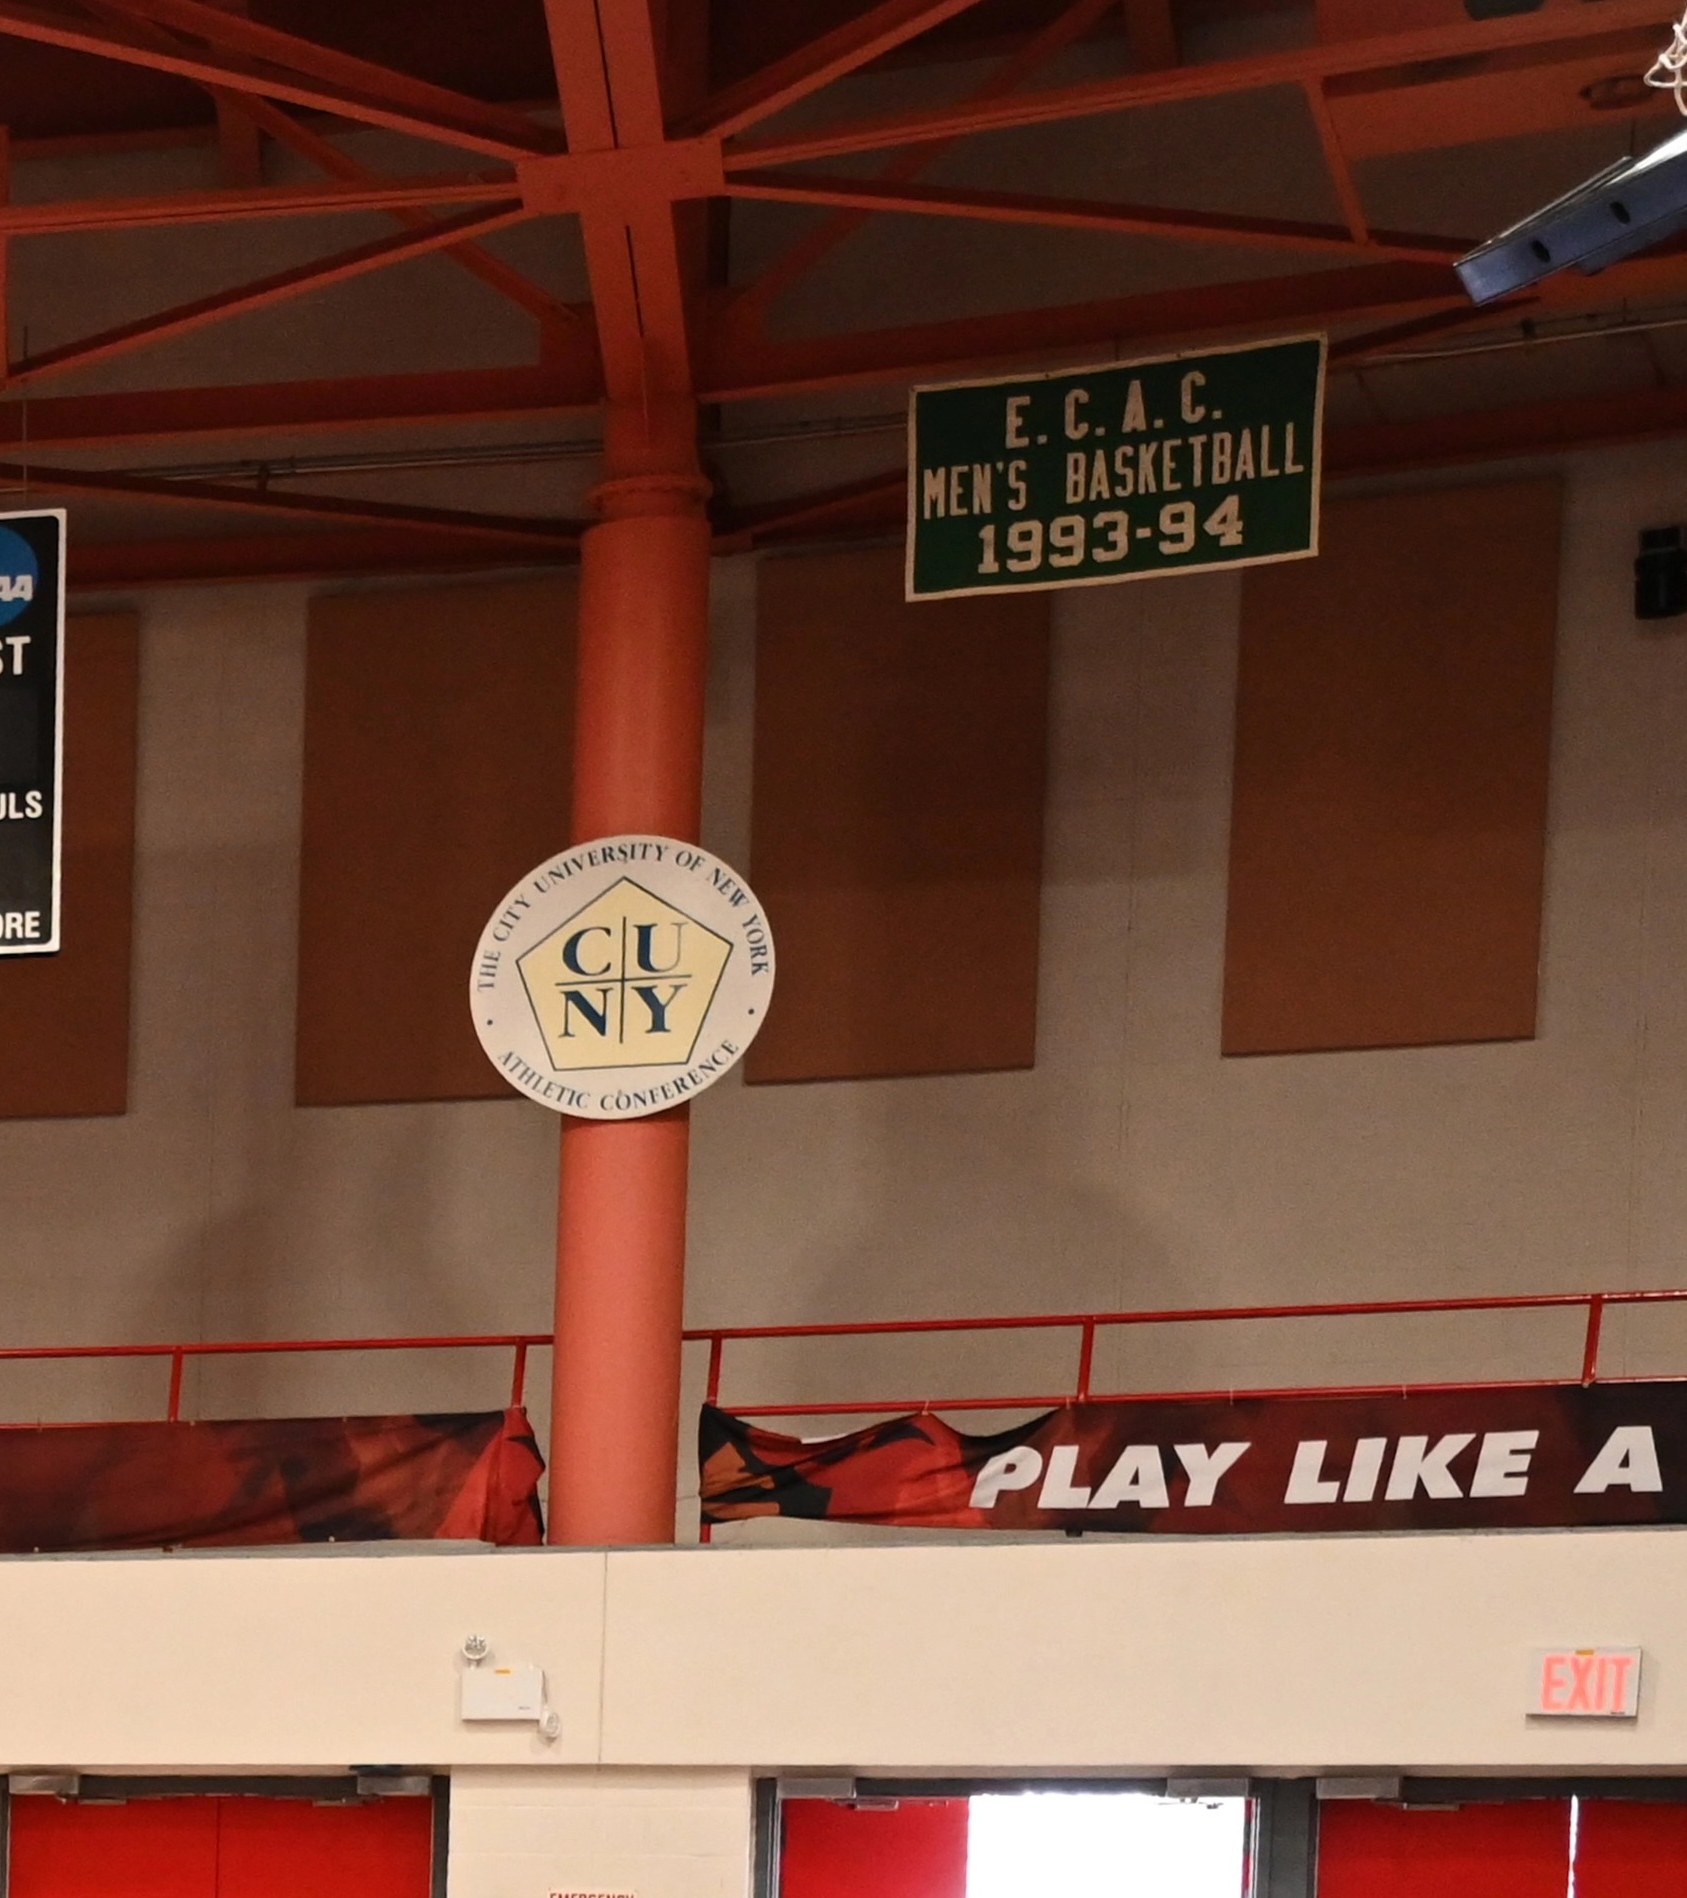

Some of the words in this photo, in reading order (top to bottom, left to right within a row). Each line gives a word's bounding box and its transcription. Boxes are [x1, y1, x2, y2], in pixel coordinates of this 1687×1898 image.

[923, 460, 1027, 520] MEN'S
[1065, 422, 1305, 504] BASKETBALL
[978, 495, 1244, 574] 1993-94
[477, 950, 501, 992] THE
[492, 894, 532, 943] CITY
[533, 843, 671, 894] UNIVERSITY
[675, 849, 706, 873] OF
[706, 867, 750, 908] NEW
[741, 913, 769, 976] YORK
[497, 1051, 591, 1110] ATHLETIC
[599, 1039, 740, 1112] CONFERENCE
[969, 1441, 1251, 1510] PLAY
[1283, 1430, 1540, 1505] LIKE
[1573, 1425, 1664, 1494] A
[1541, 1653, 1633, 1712] EXIT
